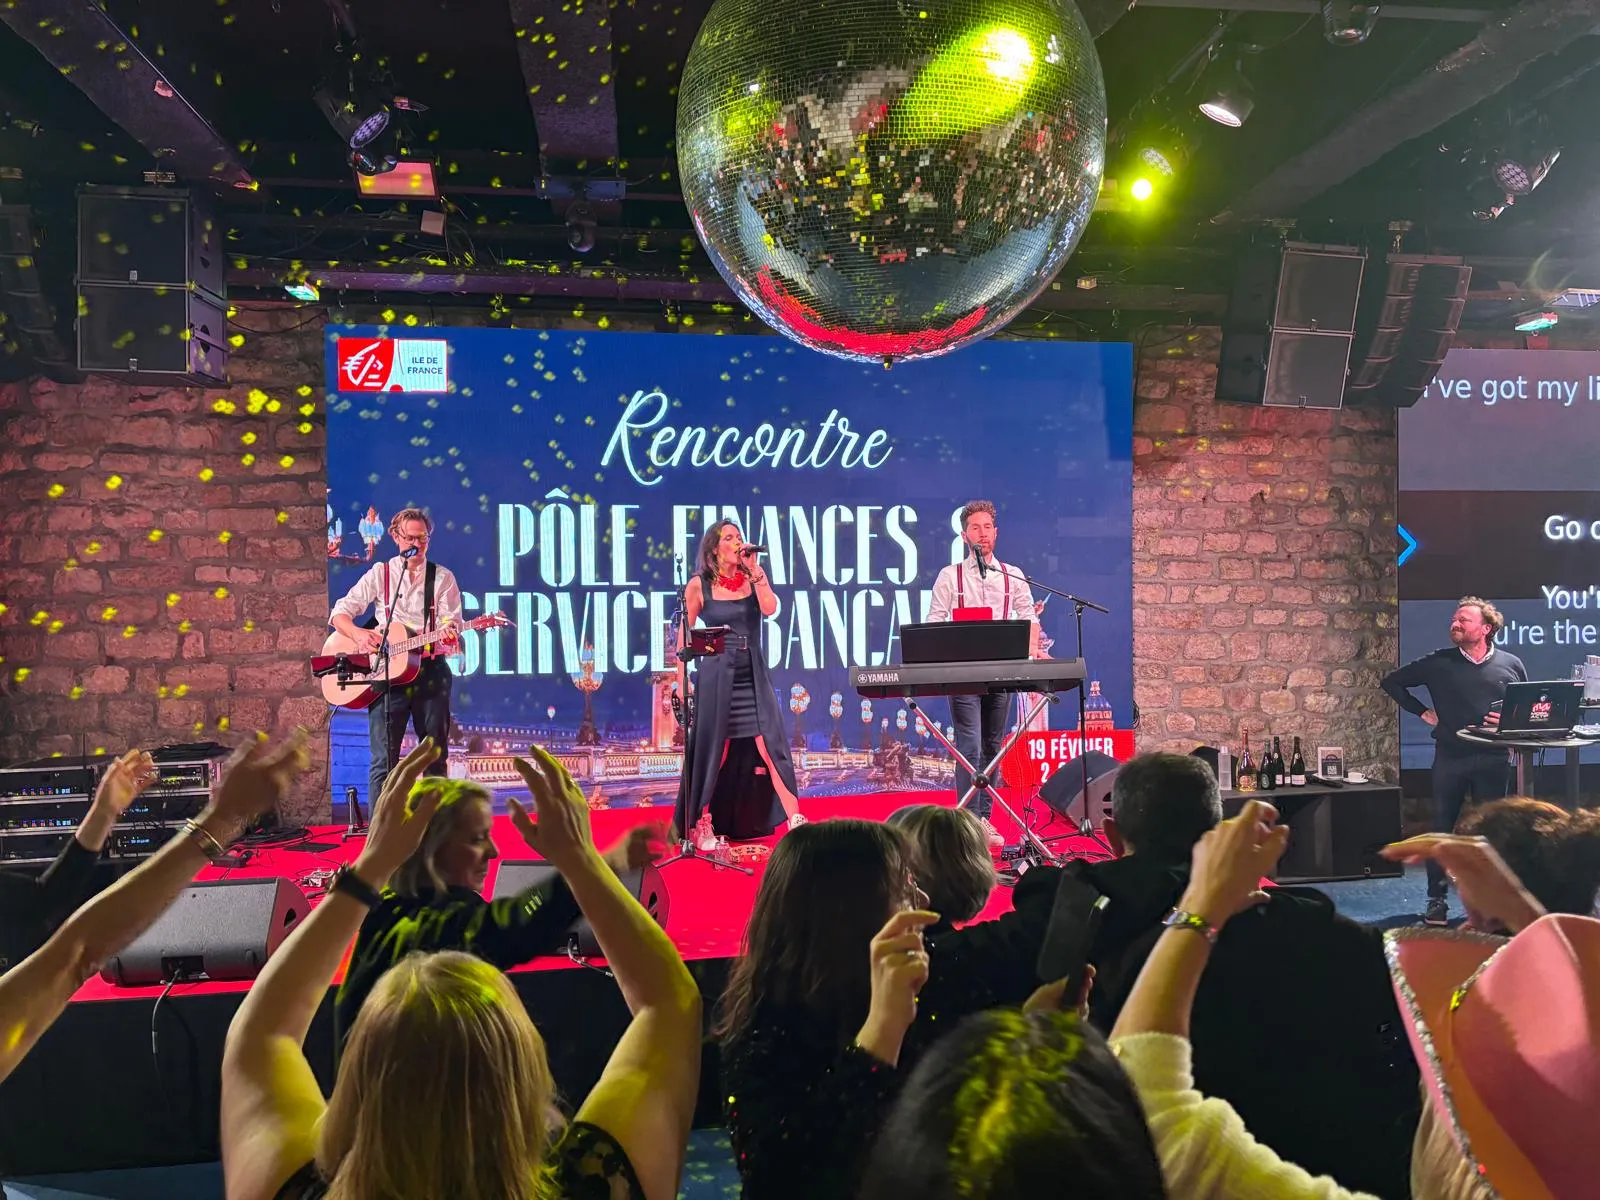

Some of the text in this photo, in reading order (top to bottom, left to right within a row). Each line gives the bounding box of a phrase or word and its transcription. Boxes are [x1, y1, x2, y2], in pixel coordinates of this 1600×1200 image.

[407, 366, 443, 375] FRANCE
[411, 356, 438, 365] ILE DE
[1482, 376, 1528, 405] got
[1537, 381, 1578, 407] my
[600, 390, 893, 486] Rencontre
[498, 487, 641, 587] PÔLE
[1544, 515, 1581, 540] Go
[1553, 619, 1596, 644] the
[867, 672, 900, 683] YAMAHA
[1028, 739, 1046, 760] 19
